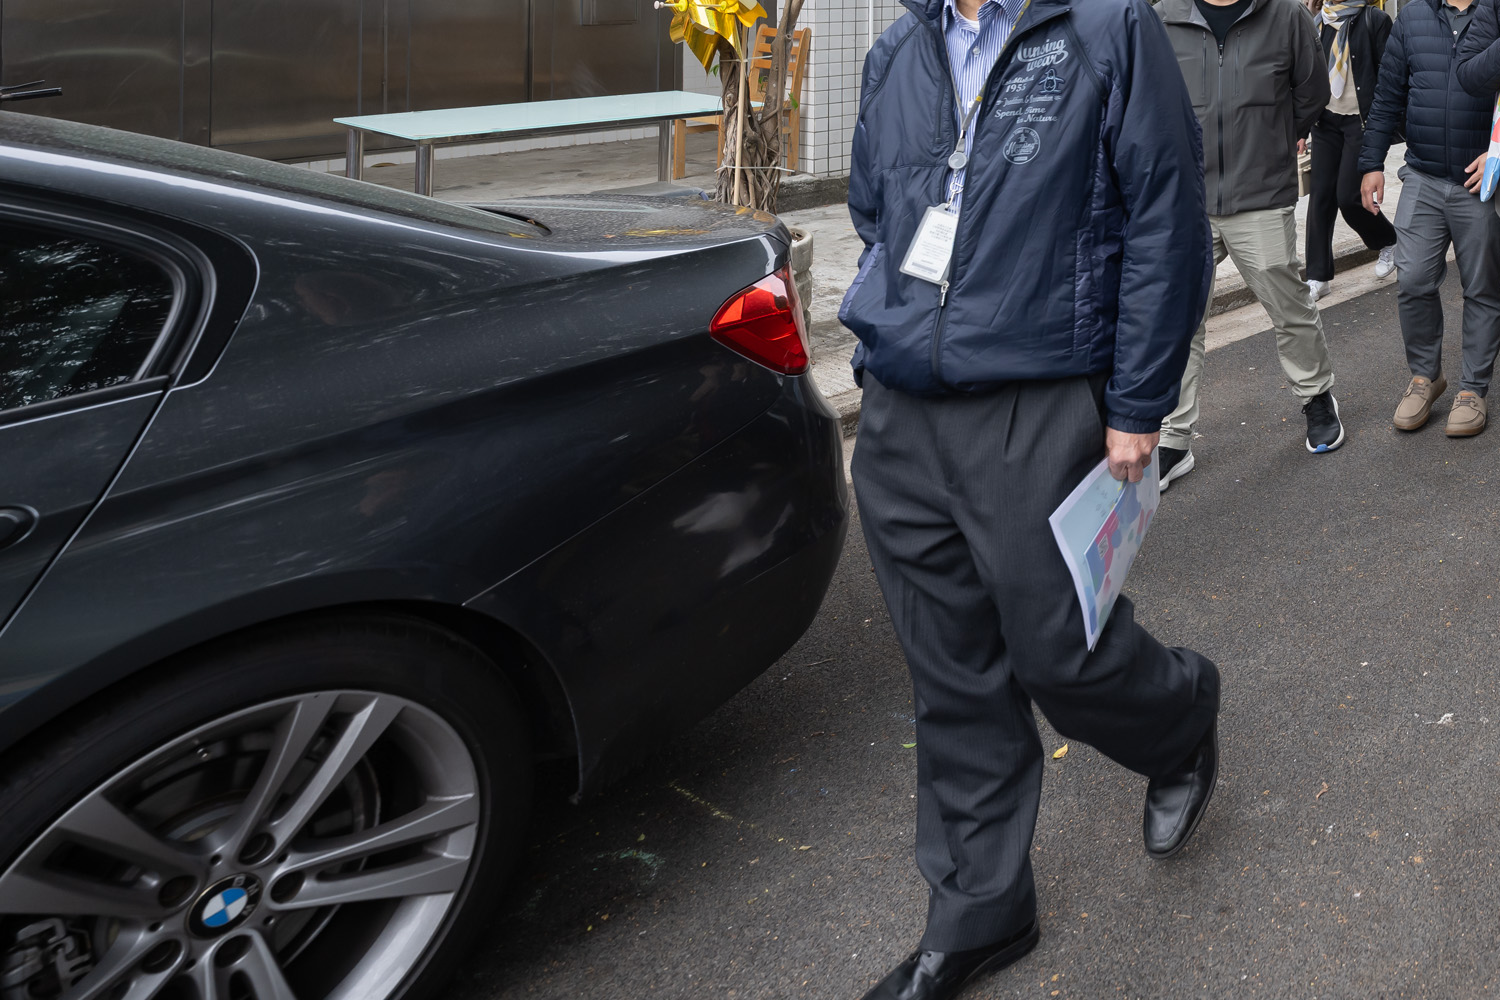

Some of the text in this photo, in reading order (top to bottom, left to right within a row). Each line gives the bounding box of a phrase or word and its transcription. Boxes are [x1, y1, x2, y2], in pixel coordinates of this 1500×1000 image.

[1006, 83, 1027, 94] 1955
[995, 108, 1022, 120] Spend
[1024, 114, 1058, 123] Nature
